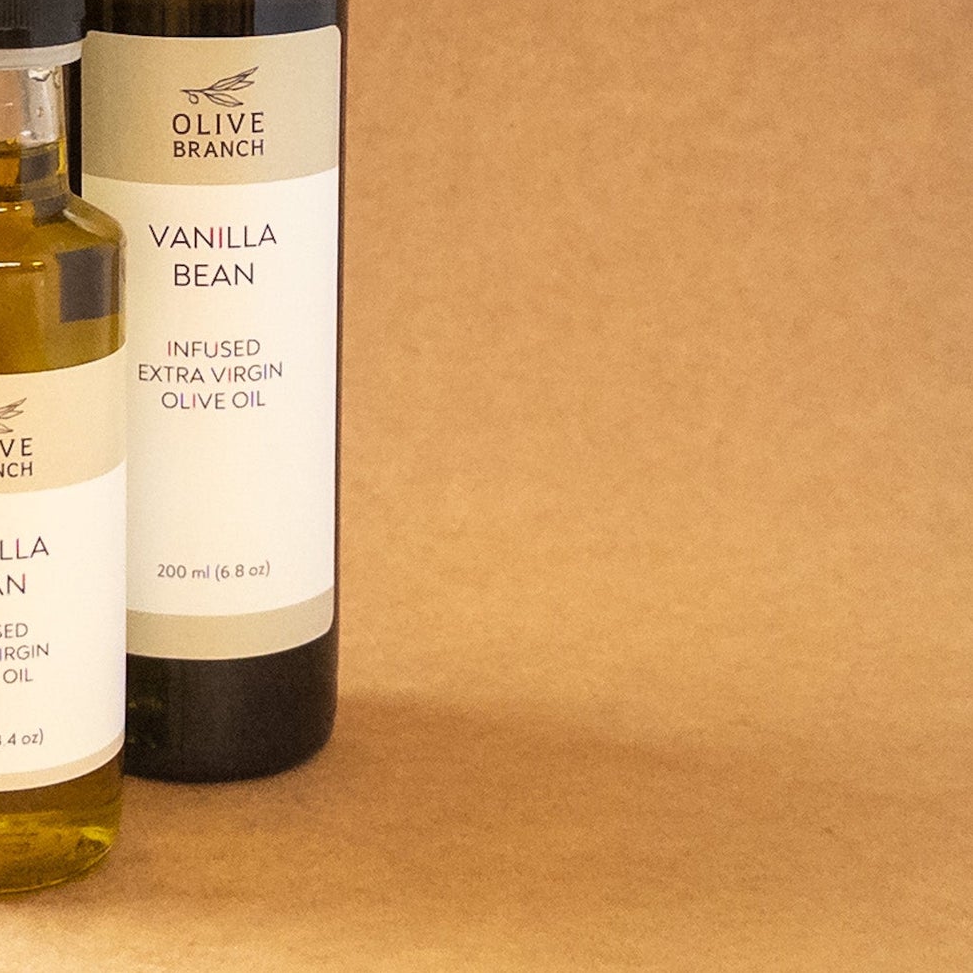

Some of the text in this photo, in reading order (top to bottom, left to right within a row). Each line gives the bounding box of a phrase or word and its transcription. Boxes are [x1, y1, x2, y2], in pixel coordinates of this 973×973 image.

[171, 111, 265, 136] OLIVE
[172, 138, 265, 159] BRANCH
[148, 223, 278, 250] VANILLA
[173, 261, 255, 288] BEAN
[167, 338, 261, 359] INFUSED
[138, 361, 283, 384] EXTRA VIRGIN
[160, 390, 266, 410] OLIVE OIL
[157, 563, 187, 579] 200
[191, 564, 210, 579] ml
[248, 560, 271, 577] oz)
[2, 668, 33, 685] OIL
[21, 728, 44, 746] oz)
